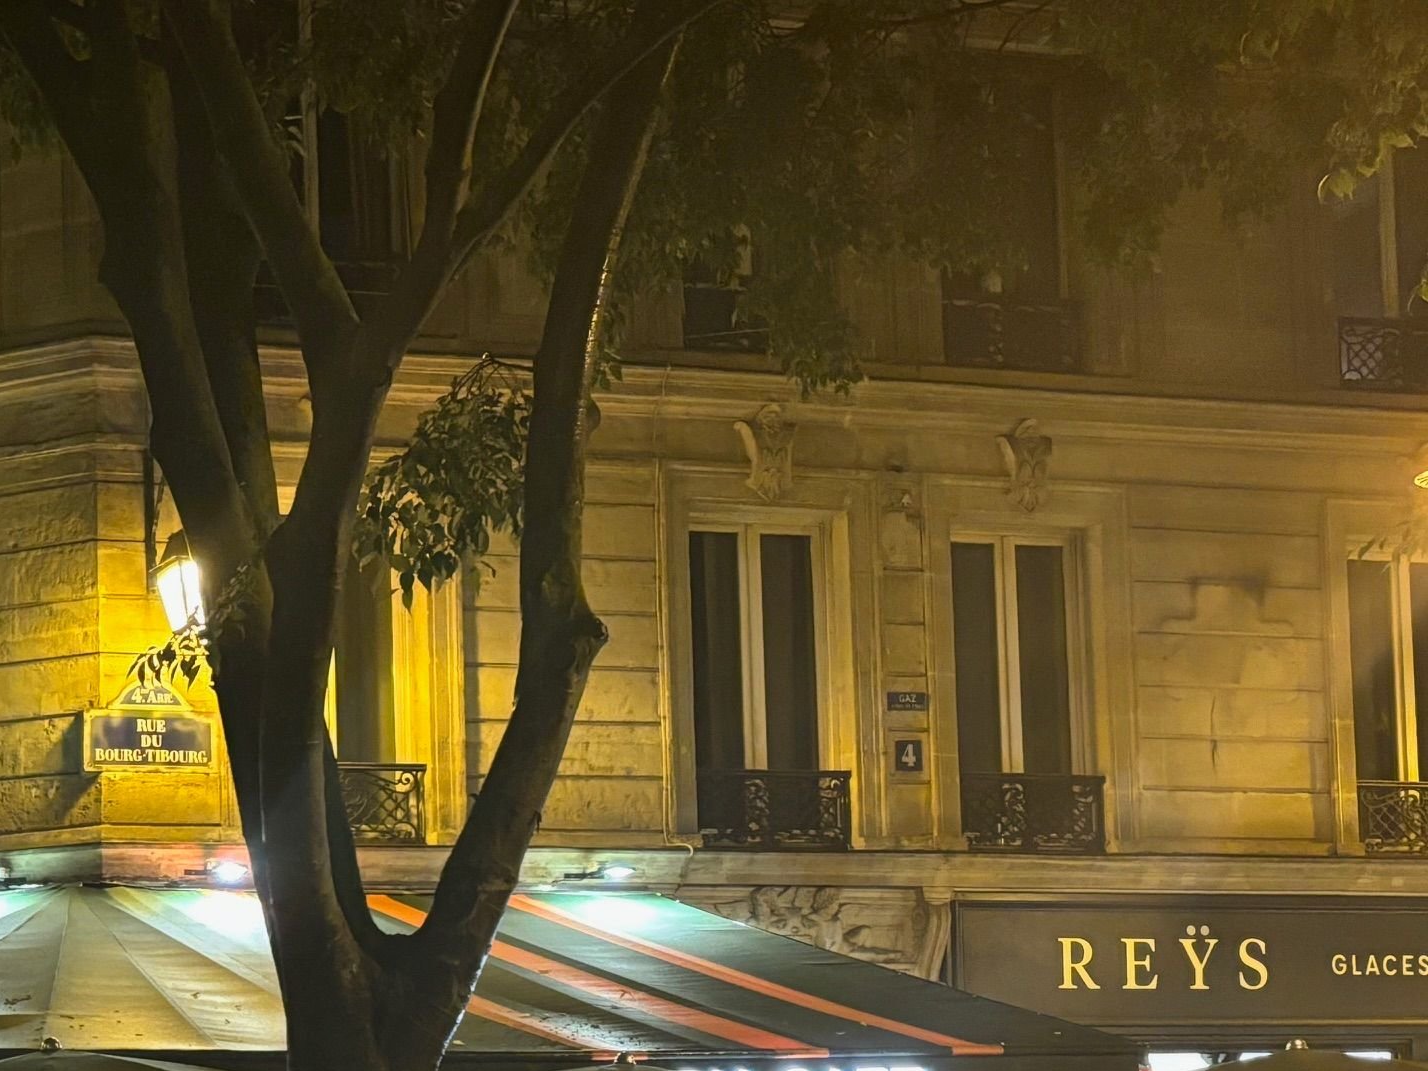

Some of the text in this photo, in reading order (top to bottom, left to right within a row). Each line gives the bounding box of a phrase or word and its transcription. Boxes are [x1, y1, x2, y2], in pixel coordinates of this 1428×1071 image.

[899, 694, 917, 703] GAZ
[136, 718, 166, 733] RUE
[140, 734, 162, 748] DU
[95, 748, 208, 764] BOURG-TIBOURG
[901, 743, 917, 767] 4
[1057, 925, 1428, 991] REŸS GLACES
